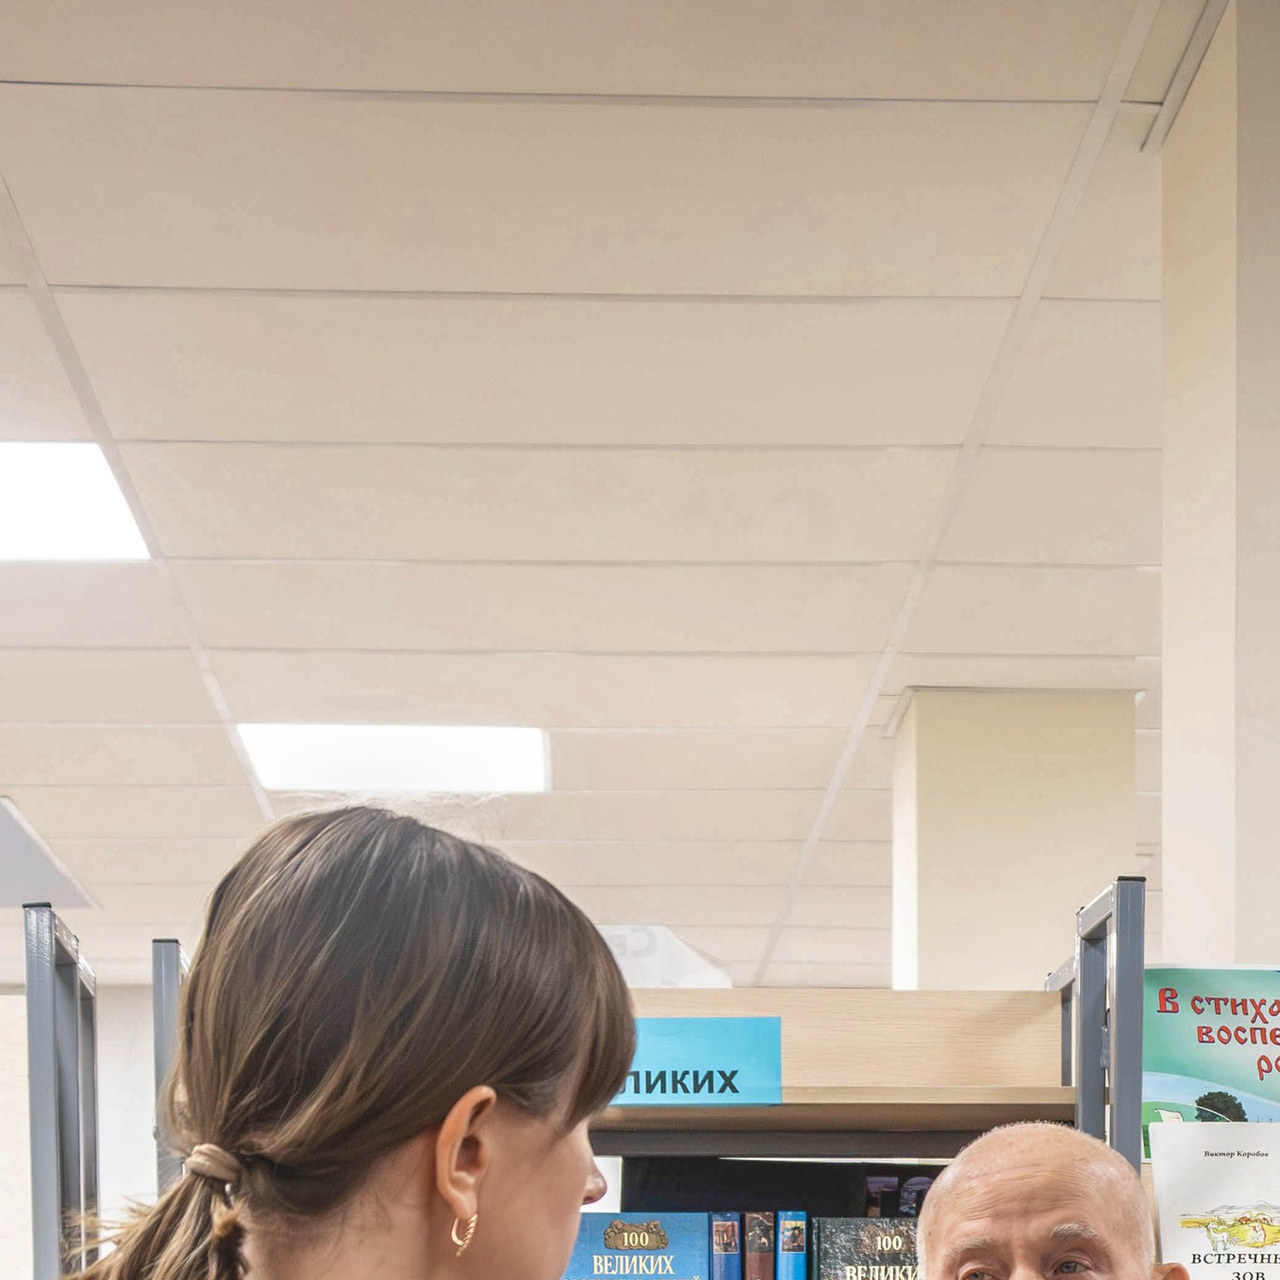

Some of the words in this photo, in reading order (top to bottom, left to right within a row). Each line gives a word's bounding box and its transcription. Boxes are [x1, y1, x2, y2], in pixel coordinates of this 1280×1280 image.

[1157, 988, 1179, 1013] В
[620, 1070, 739, 1094] ЛИКИХ
[1204, 1150, 1235, 1159] Виктор
[1236, 1150, 1269, 1159] Коробов
[622, 1231, 650, 1247] 100
[876, 1235, 902, 1251] 100
[592, 1255, 675, 1275] ВЕЛИКИХ
